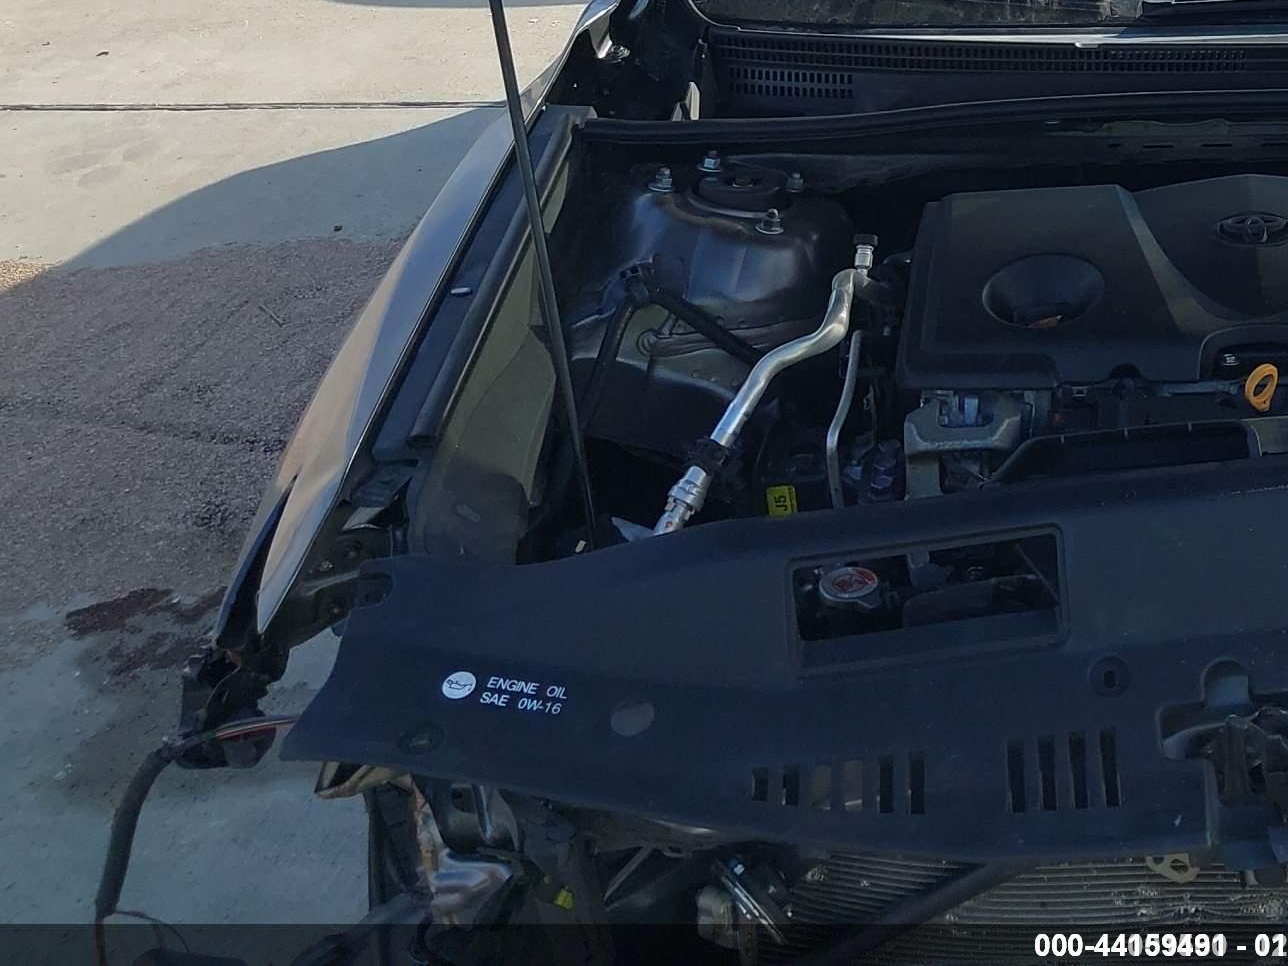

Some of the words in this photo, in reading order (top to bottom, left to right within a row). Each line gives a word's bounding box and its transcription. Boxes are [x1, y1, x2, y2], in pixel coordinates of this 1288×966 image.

[774, 495, 788, 512] J5
[486, 676, 540, 695] ENGINE
[546, 685, 568, 700] OIL
[479, 691, 510, 707] SAE
[517, 697, 562, 715] 0W-16
